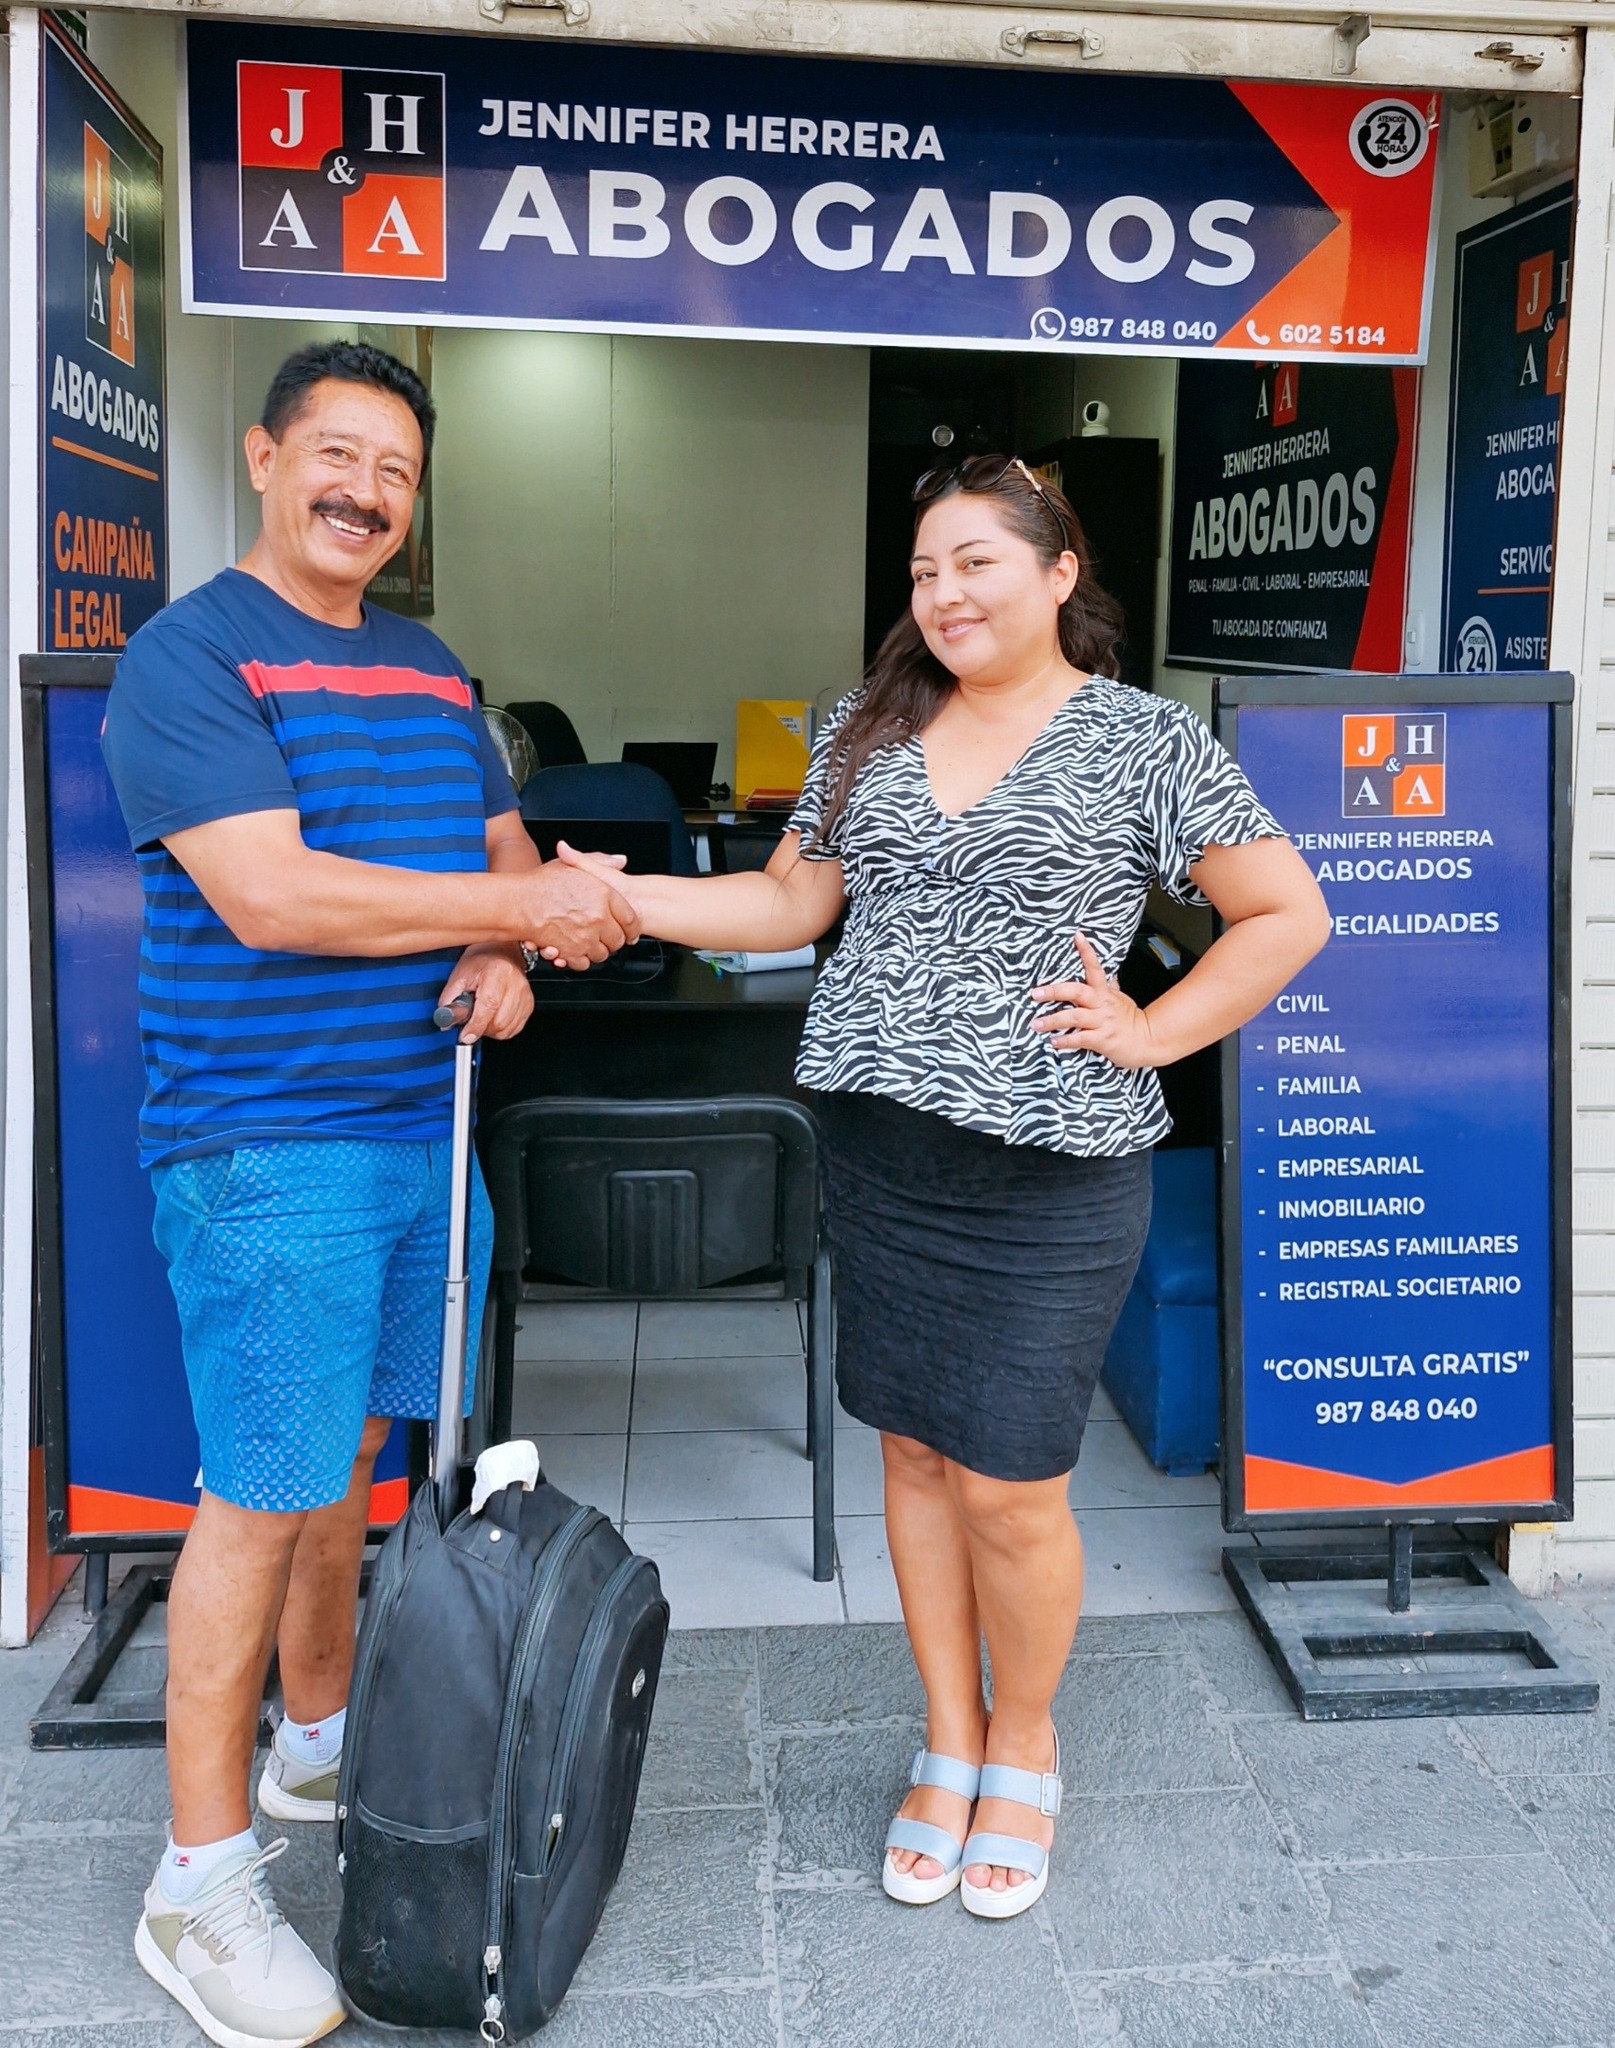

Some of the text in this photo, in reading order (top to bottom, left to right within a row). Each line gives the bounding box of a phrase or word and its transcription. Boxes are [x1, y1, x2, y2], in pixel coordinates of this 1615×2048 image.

[270, 88, 426, 155] J H
[478, 98, 945, 162] JENNIFER HERRERA
[1375, 122, 1407, 144] 24
[1377, 144, 1408, 153] HORAS
[327, 156, 357, 185] &
[92, 158, 129, 244] J H
[258, 188, 424, 255] A A
[479, 164, 1256, 286] ABOGADOS
[90, 261, 130, 342] A A
[1526, 270, 1542, 315] J
[1070, 316, 1217, 341] 987 848 040
[1279, 324, 1386, 346] 602 5184
[1519, 343, 1539, 387] A
[51, 354, 160, 453] ABOGADOS
[1255, 370, 1293, 419] A A
[1222, 427, 1330, 479] JENNIFER HERRERA
[1485, 424, 1544, 458] JENNIFER
[1495, 462, 1556, 501] ABOGA
[1189, 466, 1376, 561] ABOGADOS
[54, 510, 156, 581] CAMPAÑA
[1189, 579, 1208, 593] PENAL
[1212, 577, 1237, 592] FAMILIA
[1242, 575, 1260, 591] CIVIL
[1265, 573, 1302, 591] LABORAL
[1308, 569, 1370, 589] EMPRESARIAL
[54, 588, 127, 648] LEGAL
[1212, 619, 1328, 640] TU ABOGADA DE CONFIANZA
[1466, 646, 1487, 672] 24
[1504, 636, 1548, 660] ASISTE
[1358, 724, 1435, 757] J H
[1386, 757, 1401, 772] &
[1352, 774, 1434, 806] A A
[1294, 829, 1494, 850] JENNIFER HERRERA
[1316, 857, 1473, 883] ABOGADOS
[1276, 994, 1330, 1013] CIVIL
[1277, 1035, 1346, 1054] PENAL
[1277, 1075, 1362, 1096] FAMILIA
[1277, 1116, 1376, 1137] LABORAL
[1278, 1156, 1424, 1178] EMPRESARIAL
[1278, 1196, 1426, 1219] INMOBILIARIO
[1279, 1239, 1390, 1260] EMPRESAS
[1396, 1235, 1519, 1256] FAMILIARES
[1279, 1279, 1392, 1301] REGISTRAL
[1396, 1275, 1521, 1297] SOCIETARIO
[1315, 1397, 1478, 1425] 987 848 040
